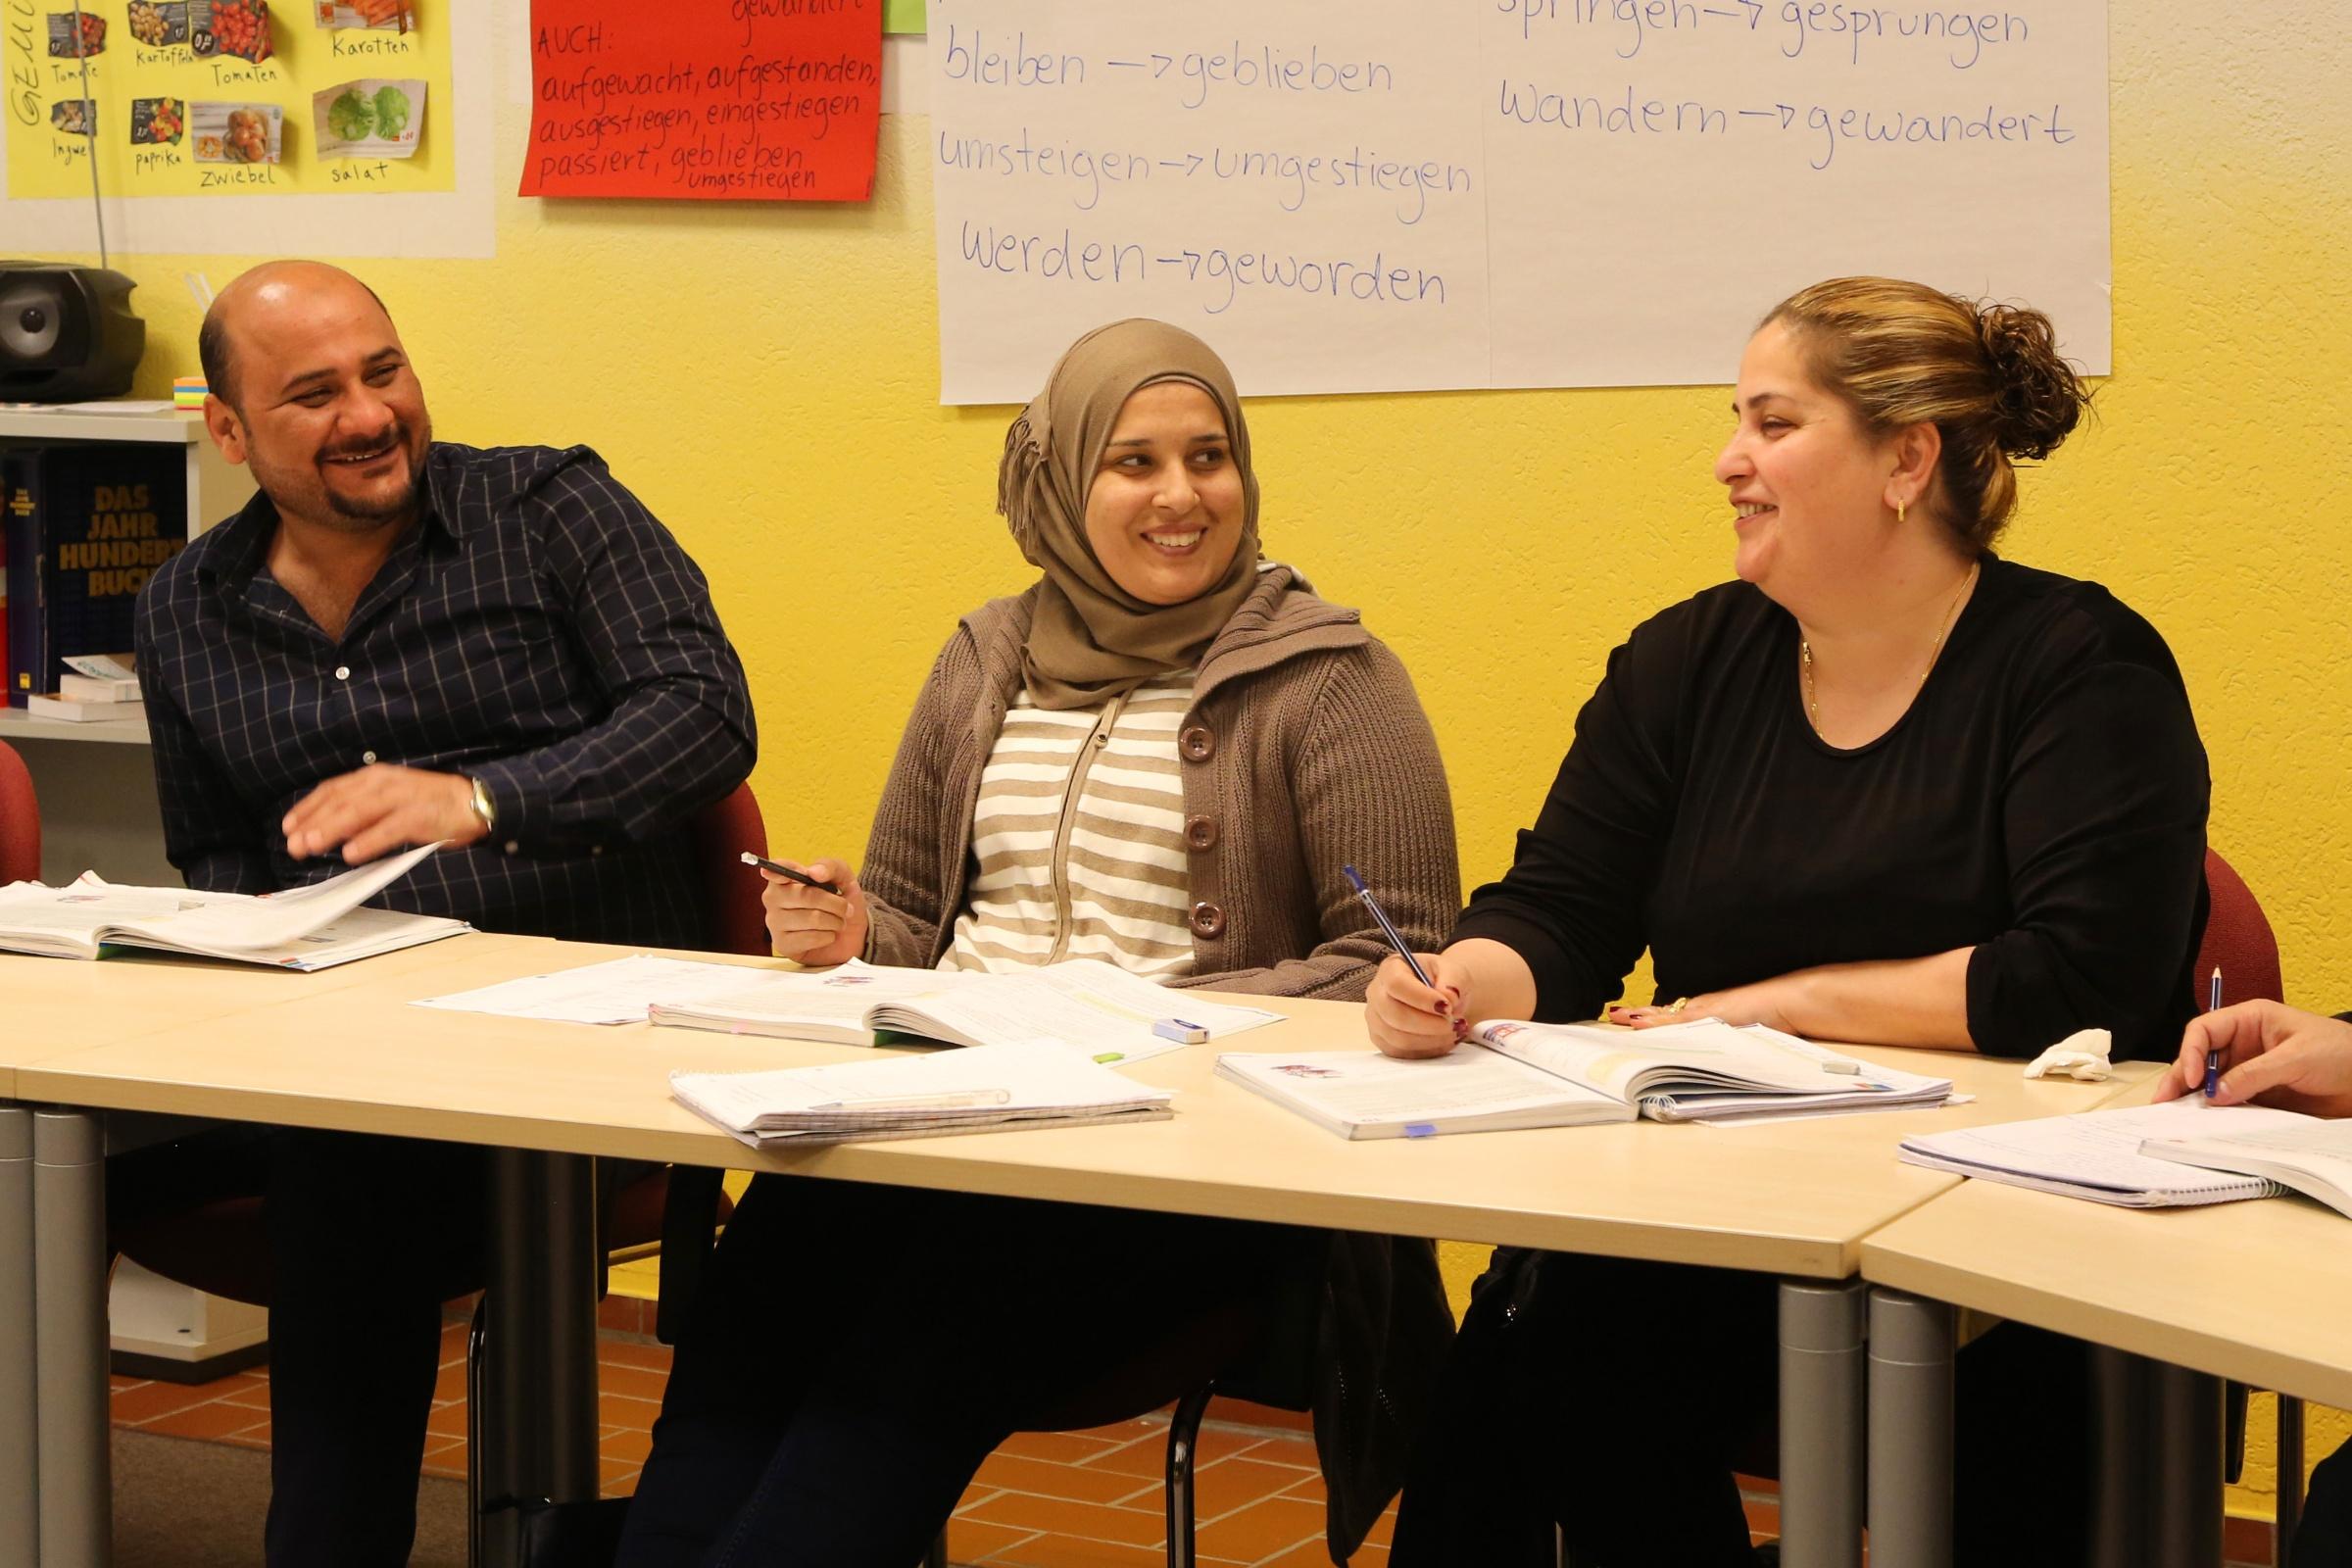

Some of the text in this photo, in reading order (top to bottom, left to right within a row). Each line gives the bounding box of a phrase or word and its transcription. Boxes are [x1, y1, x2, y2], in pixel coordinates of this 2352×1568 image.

[331, 35, 410, 58] Karotten
[537, 21, 612, 59] AUCH:
[1781, 0, 2029, 70] gesprungen
[541, 54, 878, 115] aufgewacht, aufgestanden,
[946, 24, 1393, 110] bleiben geblieben
[539, 93, 860, 151] ausgestiegen, eingestiegen
[1807, 104, 2077, 171] gewandert
[52, 137, 93, 166] Ingwe
[539, 132, 805, 189] passiert, geblieben
[940, 127, 1471, 225] umsteigen umgestiegen
[688, 168, 816, 197] umgestiegen
[1206, 250, 1446, 315] geworden
[86, 512, 158, 540] JAHR
[95, 484, 149, 511] DAS
[88, 566, 154, 597] BUC
